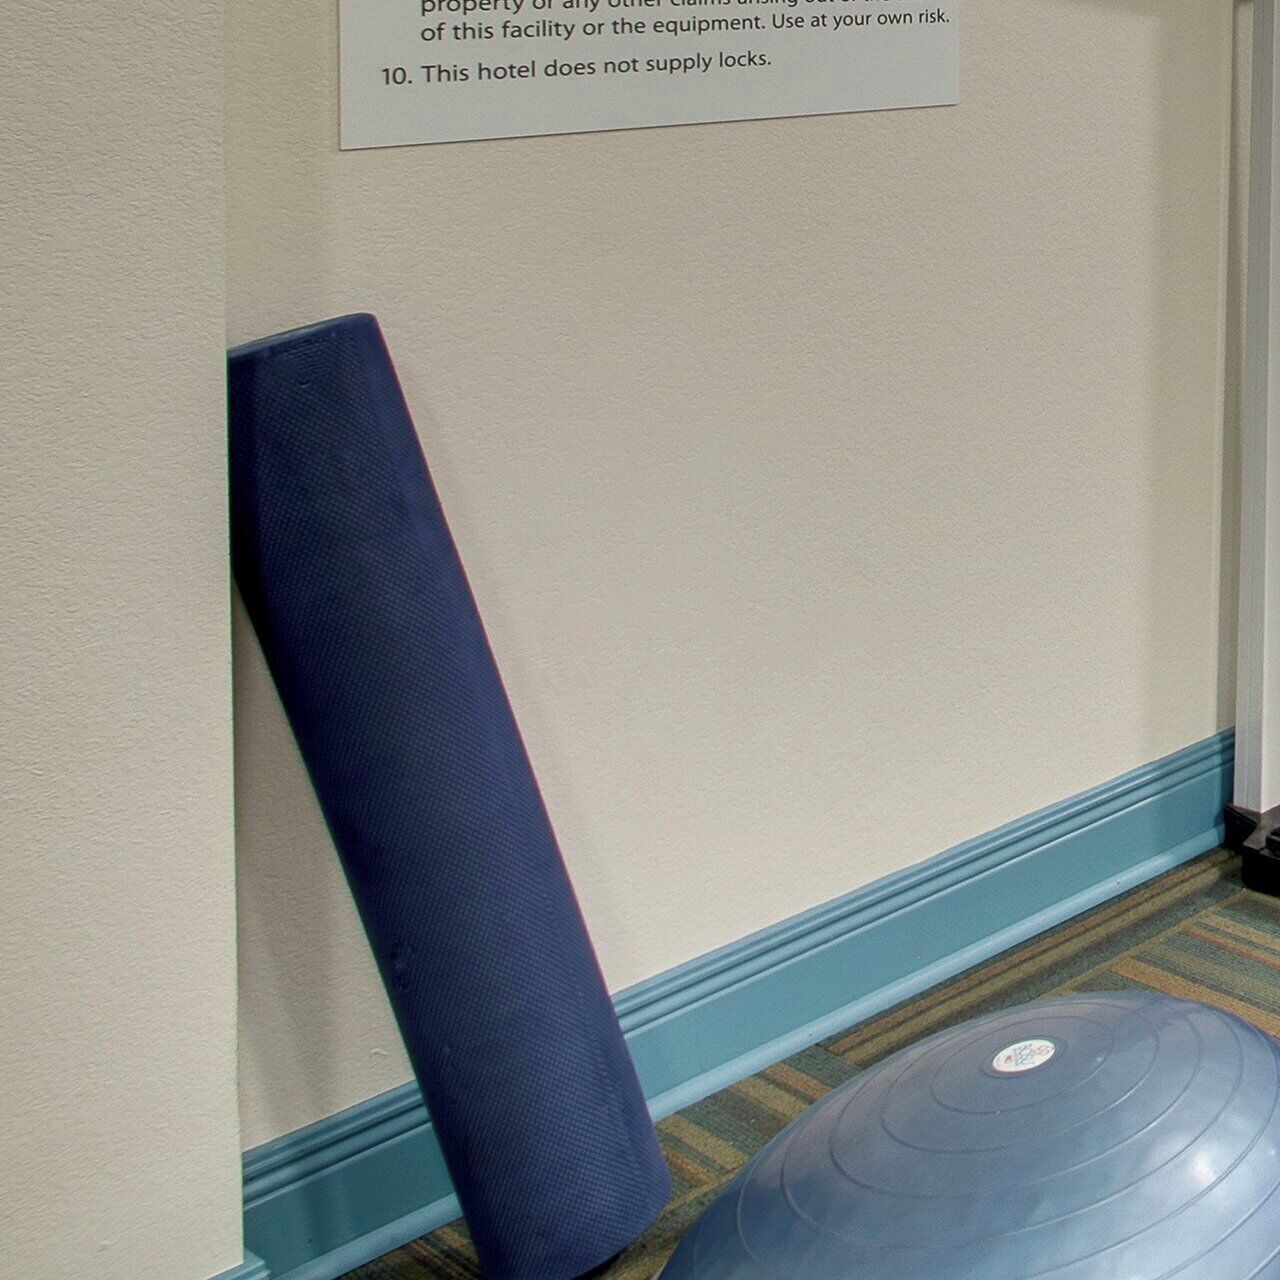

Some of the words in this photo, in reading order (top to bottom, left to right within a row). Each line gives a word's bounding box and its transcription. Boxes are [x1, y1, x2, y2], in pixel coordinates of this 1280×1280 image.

[420, 21, 446, 42] of
[451, 21, 495, 41] this
[501, 19, 576, 41] facility
[582, 22, 605, 36] or
[611, 17, 647, 35] the
[652, 15, 766, 37] equipment.
[772, 13, 805, 29] Use
[810, 13, 828, 28] at
[832, 14, 872, 31] your
[877, 12, 913, 26] own
[918, 8, 950, 24] risk.
[381, 66, 413, 86] 10.
[420, 64, 470, 83] This
[478, 59, 536, 80] hotel
[544, 59, 596, 77] does
[603, 57, 639, 74] not
[646, 52, 713, 75] supply
[719, 49, 772, 68] locks.
